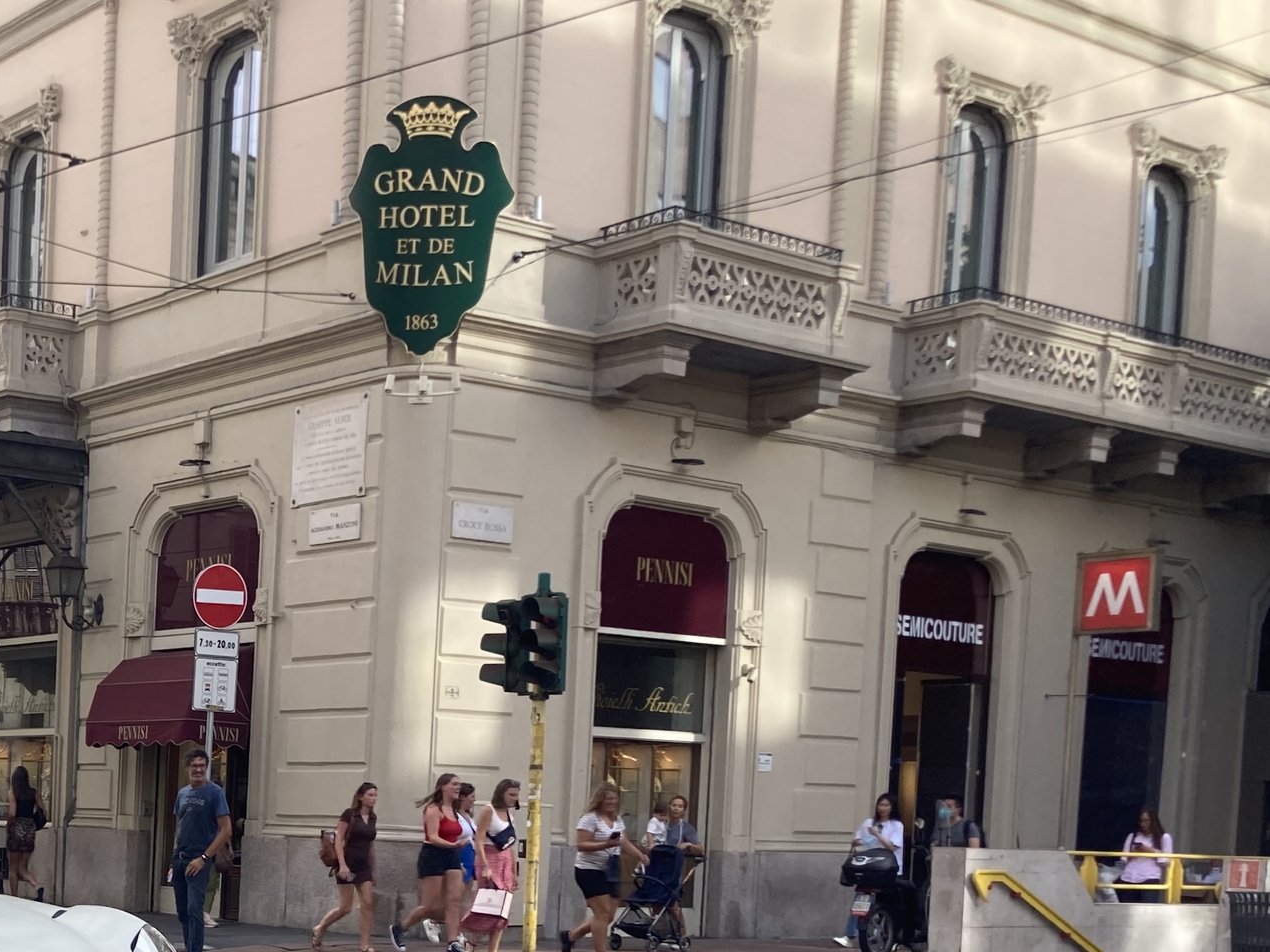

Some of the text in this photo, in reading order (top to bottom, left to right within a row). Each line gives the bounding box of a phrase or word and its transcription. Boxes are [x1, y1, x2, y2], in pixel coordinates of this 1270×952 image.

[374, 167, 485, 197] GRAND
[378, 204, 475, 229] HOTEL
[396, 238, 455, 255] ET DE
[375, 260, 475, 287] MILAN
[404, 314, 439, 331] 1863
[458, 519, 507, 533] CROCE ROSSA
[636, 556, 694, 588] PENNISI
[1085, 571, 1145, 617] M
[118, 725, 149, 740] PENNISI
[199, 724, 239, 743] PNNISI
